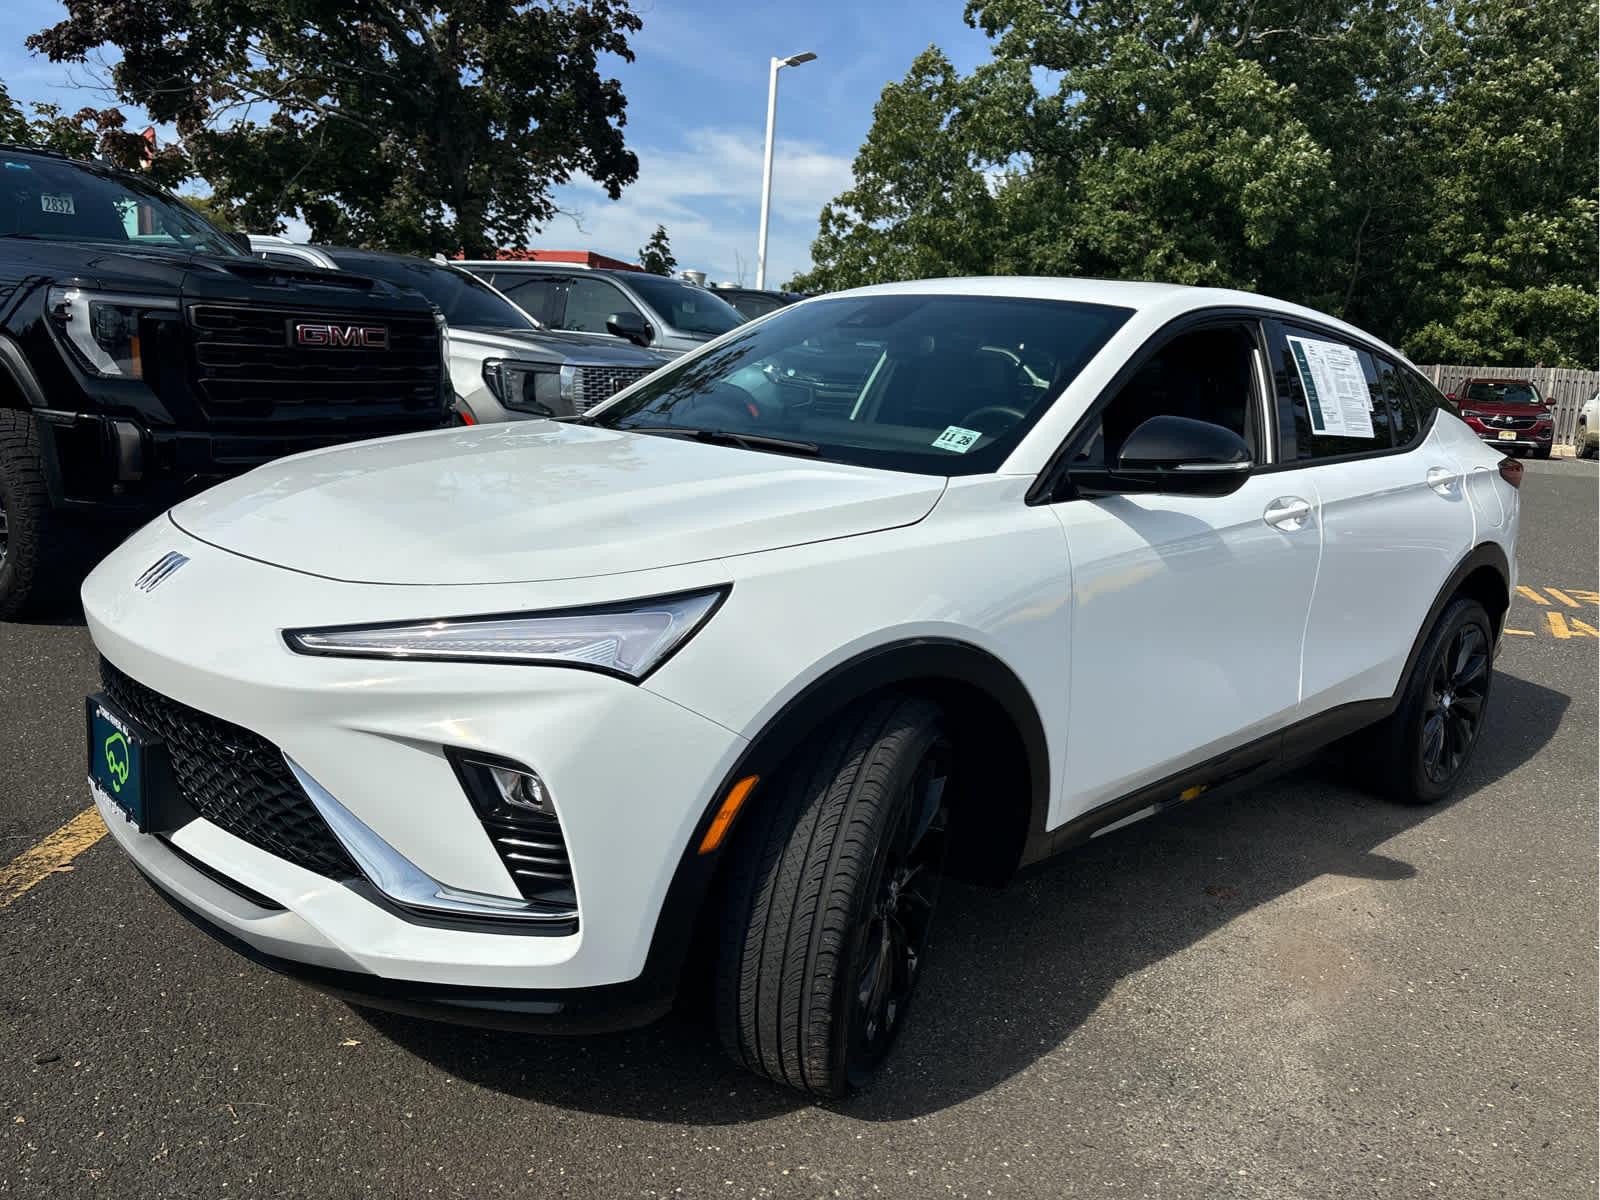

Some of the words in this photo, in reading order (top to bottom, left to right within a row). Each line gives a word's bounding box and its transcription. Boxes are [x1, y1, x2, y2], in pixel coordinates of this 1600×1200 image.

[43, 197, 73, 213] 2832
[296, 324, 386, 347] GMC
[941, 432, 956, 442] 11
